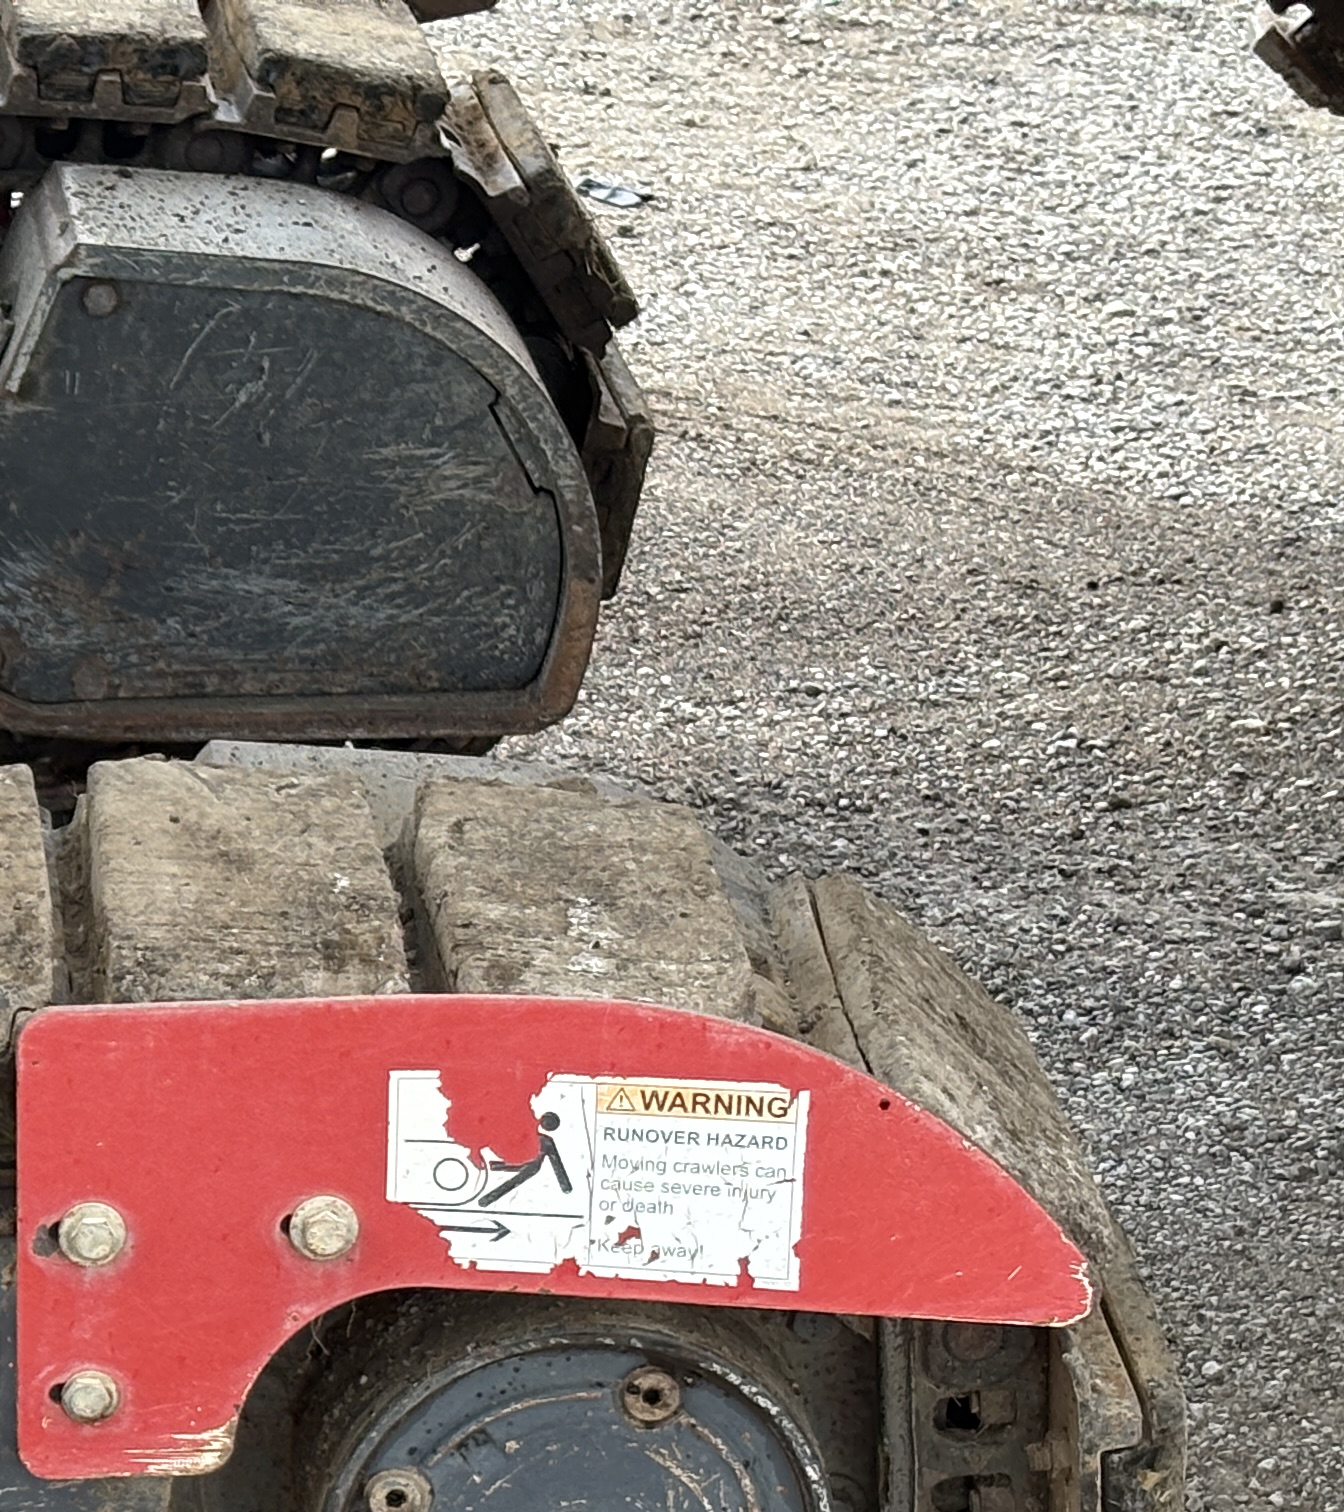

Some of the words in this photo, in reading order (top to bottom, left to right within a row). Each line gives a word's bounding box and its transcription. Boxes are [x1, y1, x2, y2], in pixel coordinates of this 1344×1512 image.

[640, 1090, 788, 1118] WARNING
[603, 1127, 700, 1146] RUNOVER
[707, 1133, 788, 1150] HAZARD
[601, 1154, 667, 1175] Moving
[673, 1160, 749, 1177] crawlers
[755, 1166, 787, 1178] can
[600, 1178, 654, 1192] cause
[660, 1183, 721, 1197] severe
[727, 1183, 776, 1203] injury
[599, 1200, 617, 1211] or
[622, 1198, 673, 1215] death
[597, 1238, 644, 1258] Keep
[651, 1244, 704, 1262] away!
